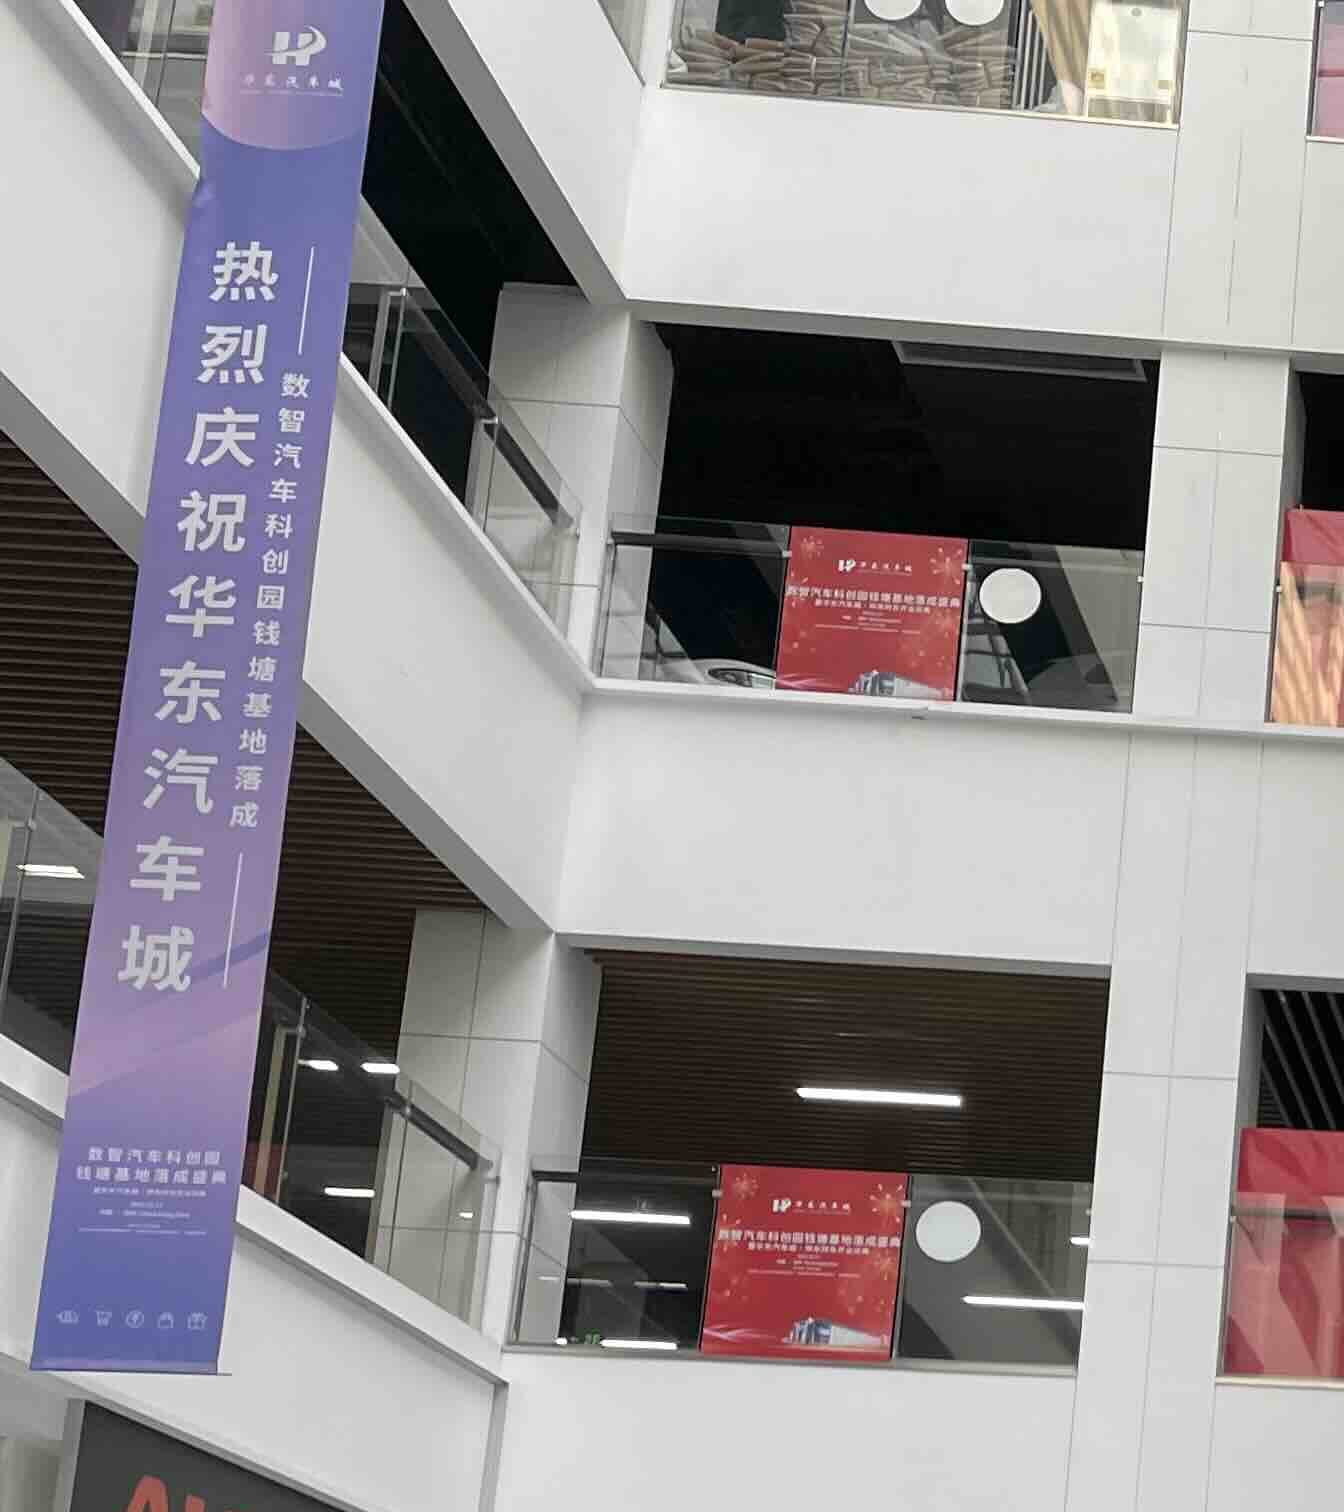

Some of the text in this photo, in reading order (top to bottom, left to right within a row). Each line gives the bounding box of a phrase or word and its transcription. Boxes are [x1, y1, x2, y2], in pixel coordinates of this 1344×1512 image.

[117, 241, 279, 992] 热烈庆祝华东汽车城
[229, 373, 311, 829] 数智汽车科创园钱塘基地落成
